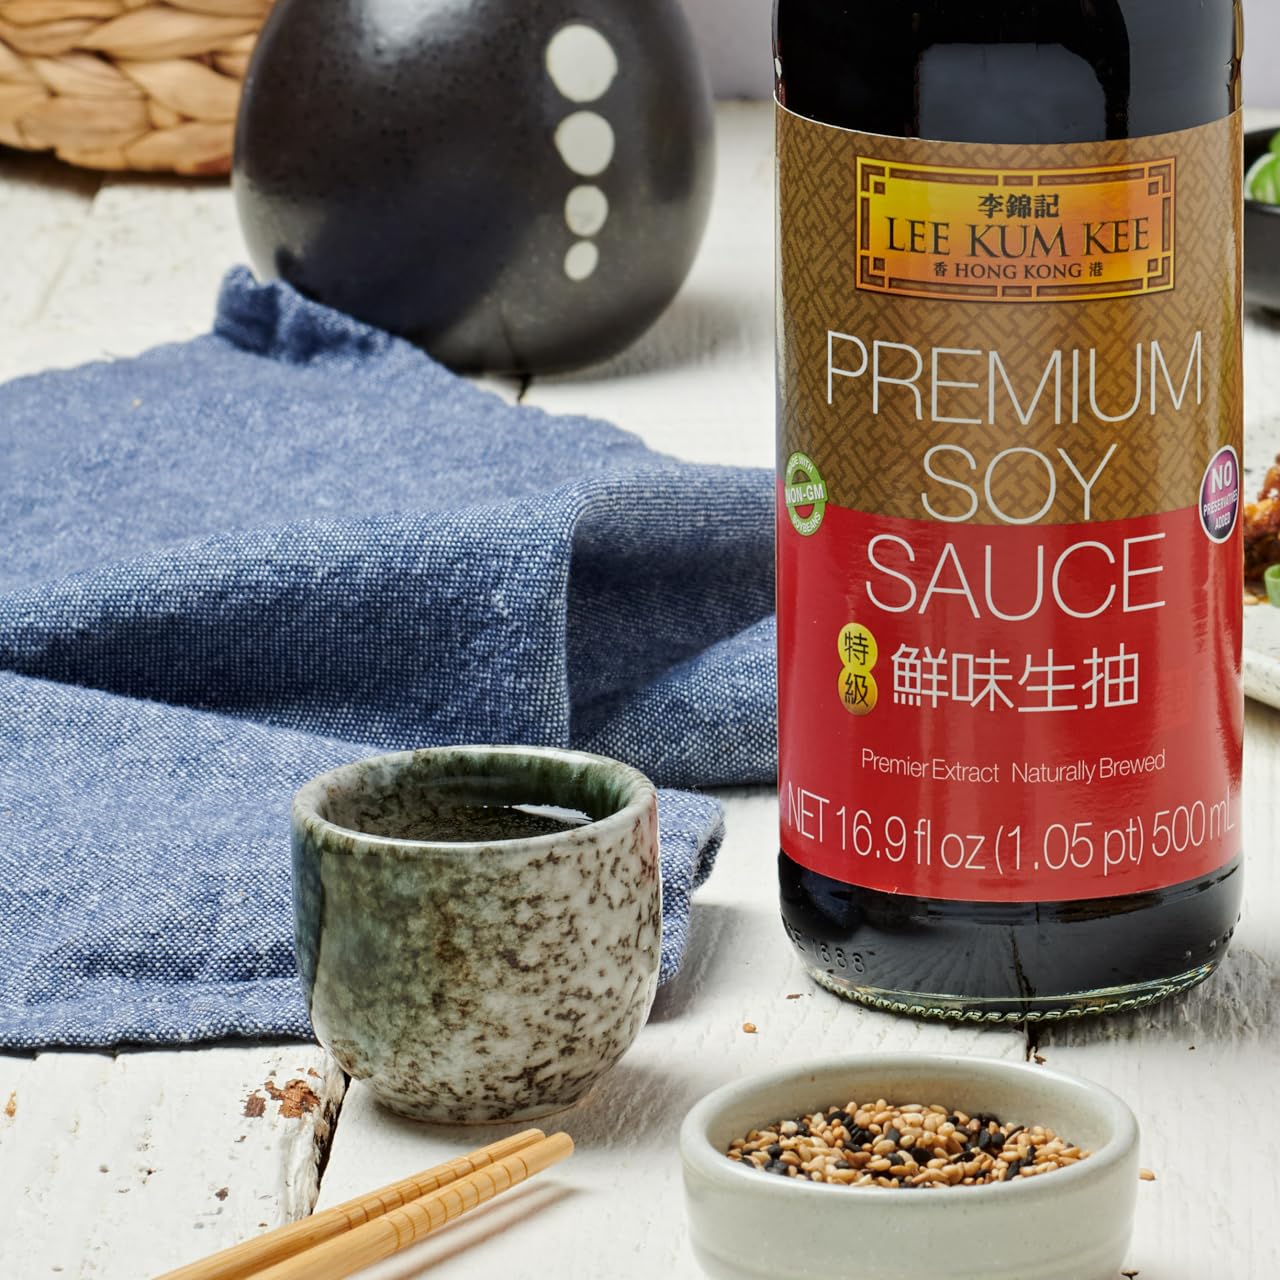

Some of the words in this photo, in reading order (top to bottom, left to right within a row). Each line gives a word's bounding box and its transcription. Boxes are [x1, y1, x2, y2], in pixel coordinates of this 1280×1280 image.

[978, 193, 1059, 219] 李錦記
[885, 216, 950, 256] LEE
[966, 223, 1070, 259] KUM
[1083, 217, 1150, 256] KEE
[933, 261, 948, 277] 香
[955, 263, 1017, 279] HONG
[1024, 263, 1082, 279] KONG
[1089, 261, 1103, 277] 港
[827, 330, 1202, 425] PREMIUM
[785, 483, 824, 503] NON-GM
[921, 444, 1118, 524] SOY
[1211, 460, 1233, 494] NO
[1214, 511, 1231, 530] ADDED
[865, 532, 1166, 621] SAUCE
[844, 631, 869, 708] 特級
[891, 642, 1139, 712] 鮮味生抽
[861, 747, 930, 779] Premier
[932, 758, 1000, 783] Extract
[1011, 759, 1097, 785] Naturally
[1099, 748, 1166, 779] Brewed
[788, 780, 831, 843] NET
[836, 805, 907, 862] 16.9
[913, 818, 931, 865] fl
[940, 832, 986, 869] oz
[995, 821, 1094, 875] (1.05
[1103, 815, 1144, 877] pt)
[1152, 800, 1206, 857] 500
[1210, 785, 1235, 841] mL
